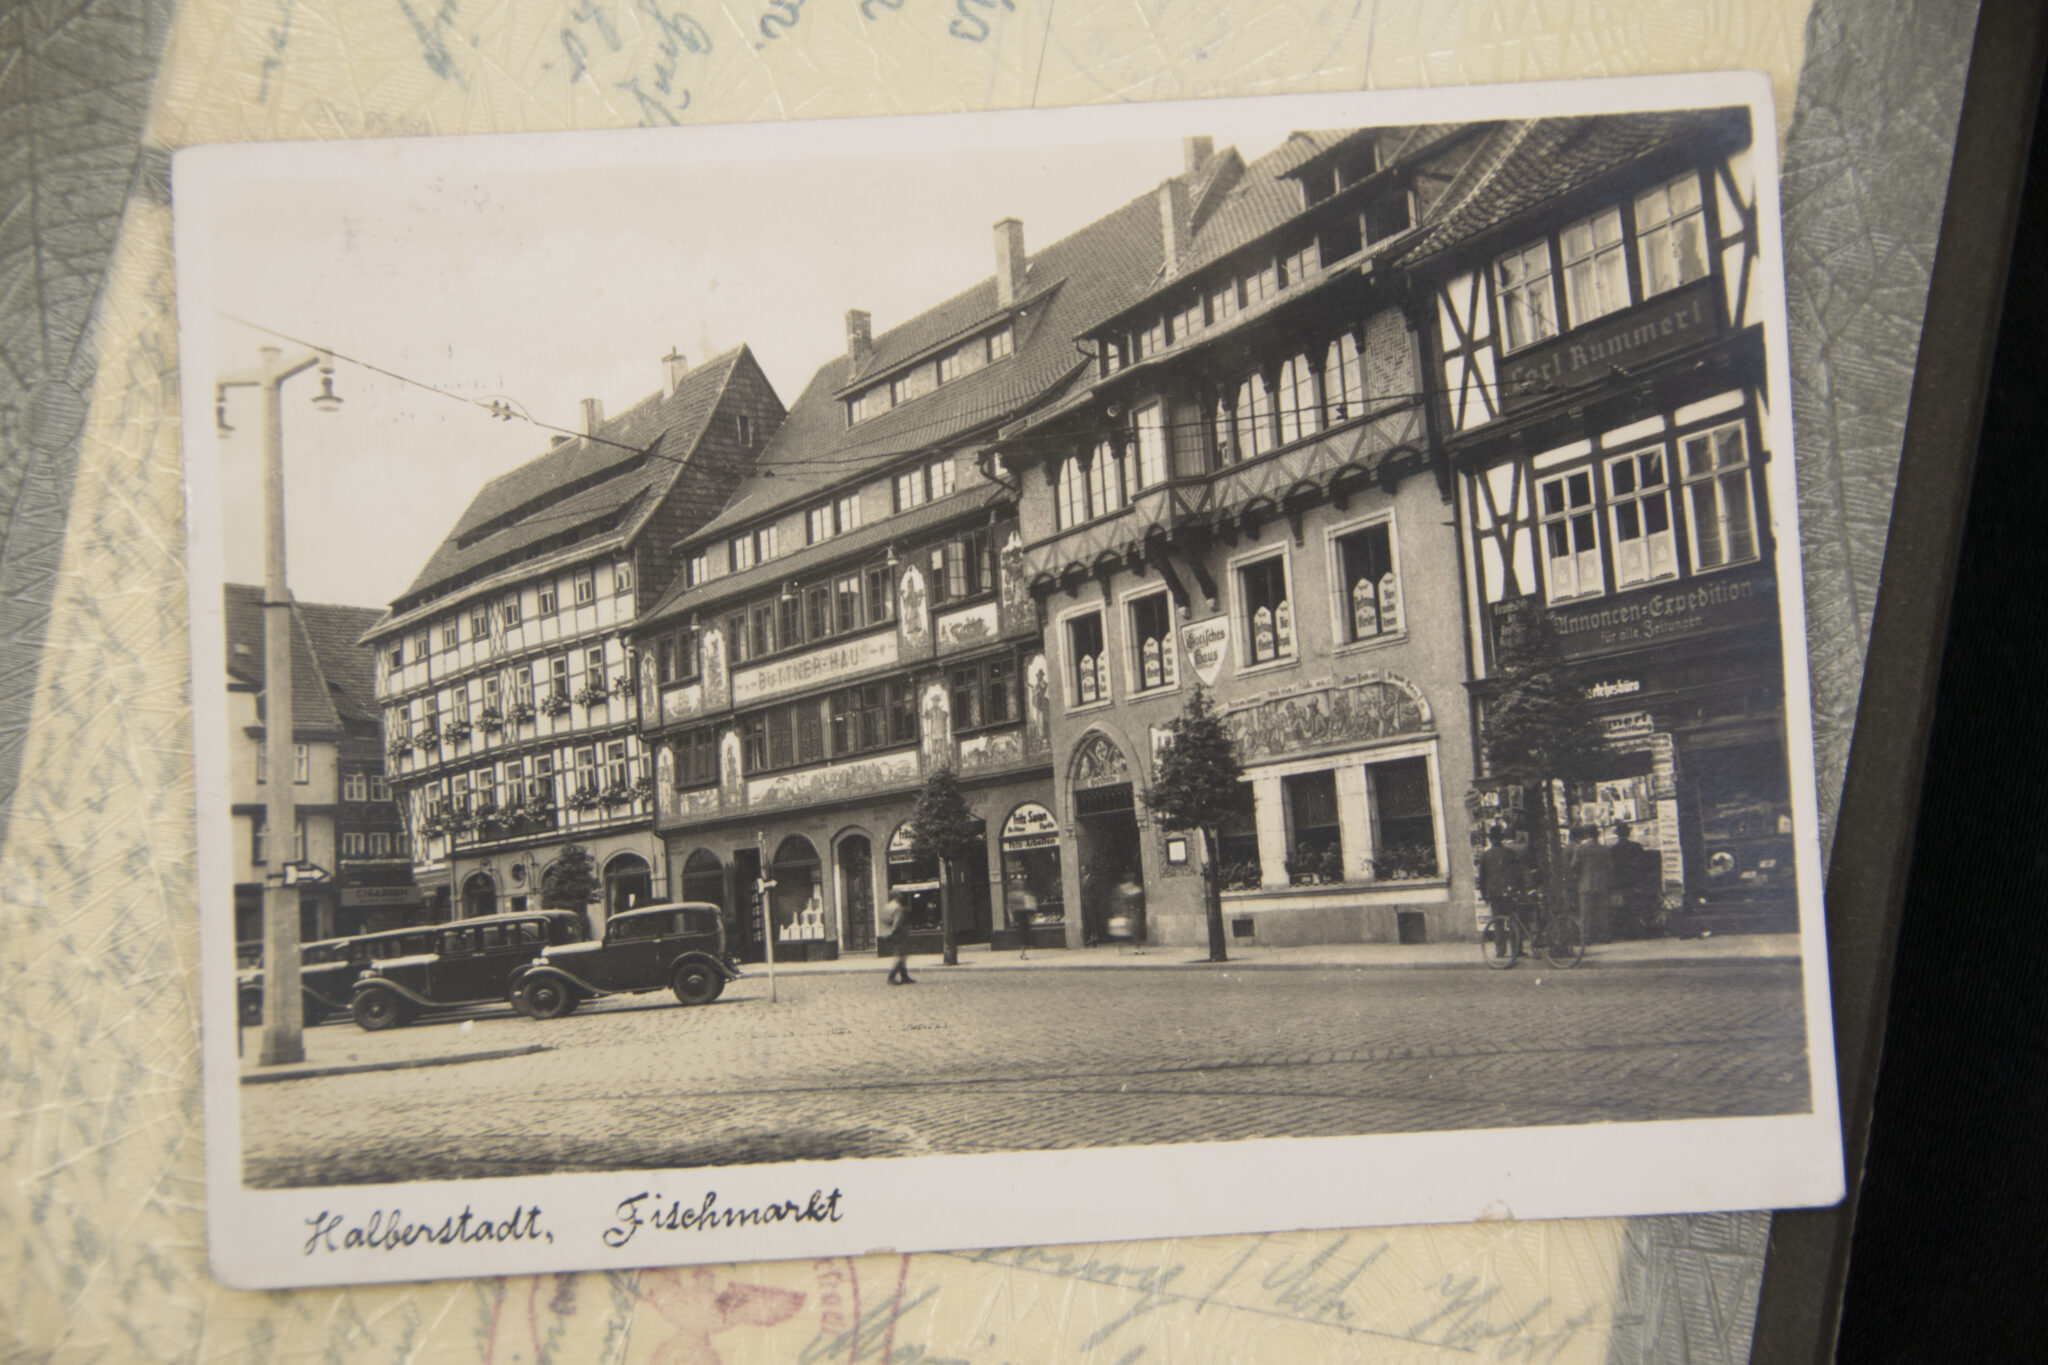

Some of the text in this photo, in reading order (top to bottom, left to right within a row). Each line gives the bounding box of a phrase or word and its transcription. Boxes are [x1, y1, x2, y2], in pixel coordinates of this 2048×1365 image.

[1186, 629, 1226, 650] Gotisches
[303, 1187, 844, 1256] Halberstadt, Fischmarkt
